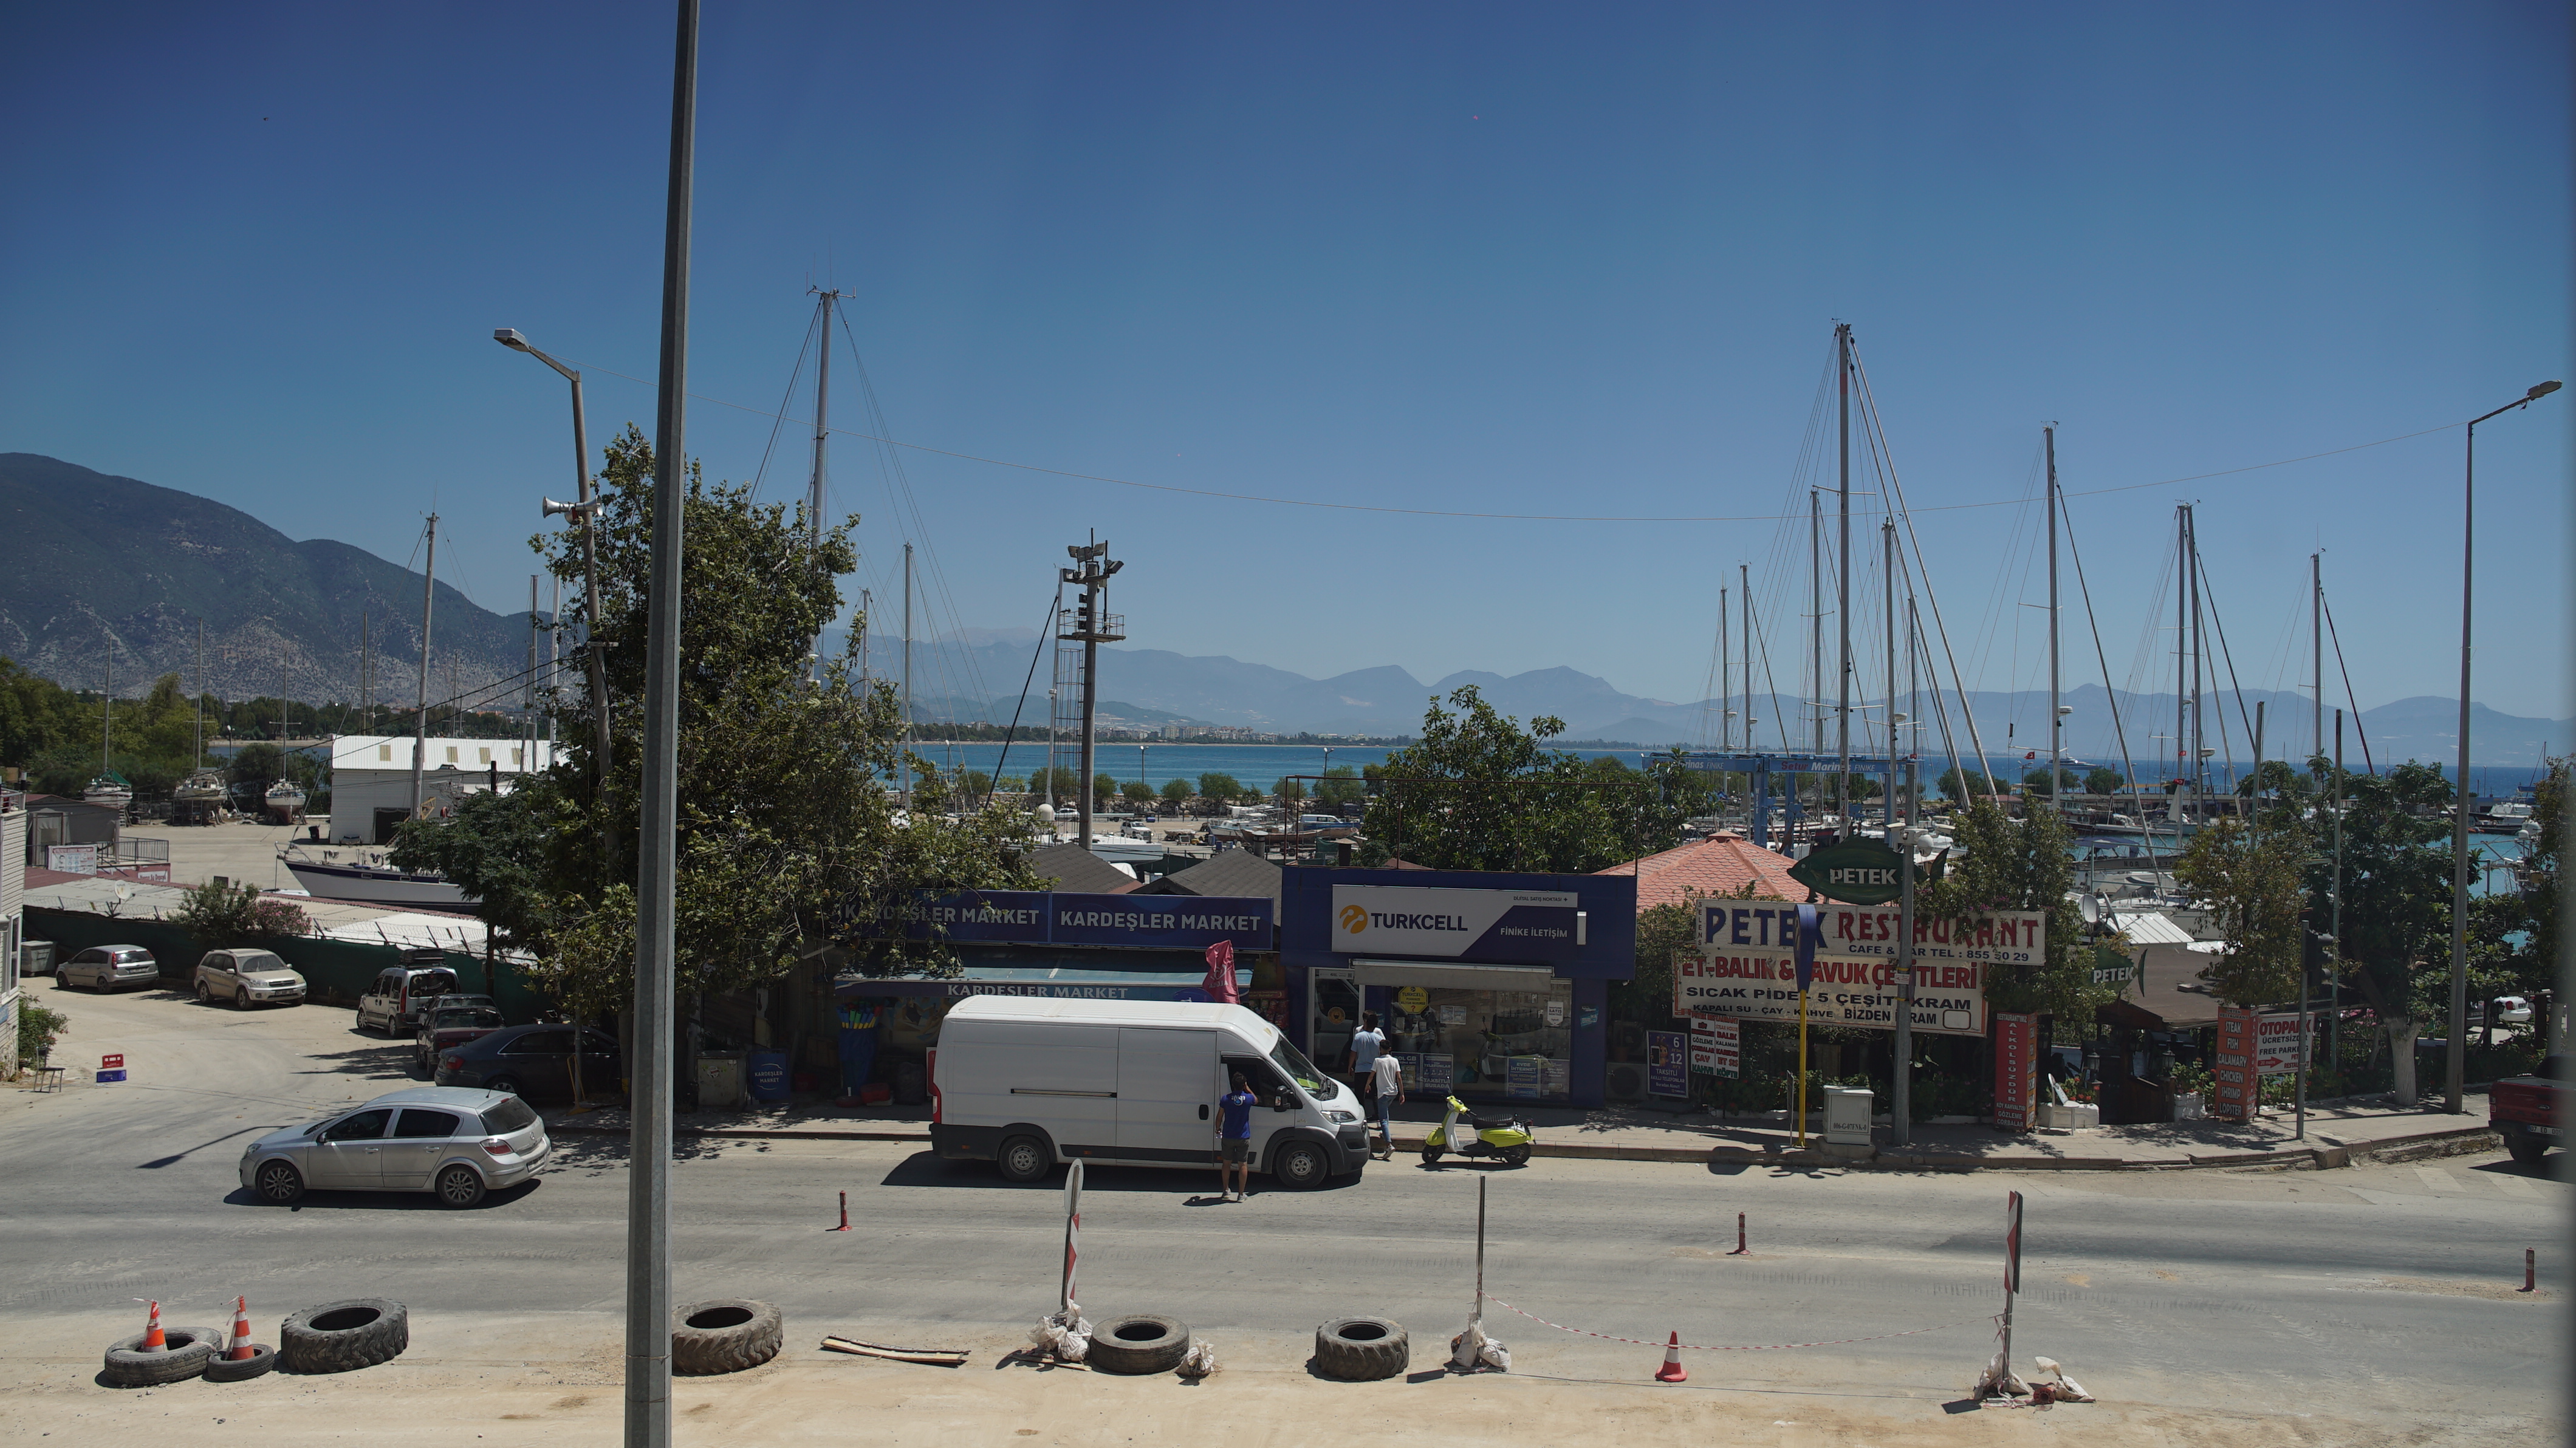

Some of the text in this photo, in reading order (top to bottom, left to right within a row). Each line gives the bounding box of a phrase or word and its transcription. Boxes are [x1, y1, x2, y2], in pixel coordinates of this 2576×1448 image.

[1781, 761, 1808, 771] Setur
[1811, 762, 1851, 772] Marins
[1829, 868, 1897, 885] PETEK
[962, 907, 1040, 924] MARKET
[1061, 911, 1261, 932] KARDEŞLER MARKET
[1371, 912, 1468, 932] TURKCELL
[1500, 926, 1568, 940] FİNİKE İLETİŞİM
[1849, 945, 1882, 954] CAFE
[1931, 949, 1954, 958] TEL
[1967, 950, 1990, 959] 855
[2013, 952, 2029, 961] 29
[1779, 960, 1795, 981] &
[1810, 961, 1869, 985] AVUK
[2093, 967, 2134, 983] PETEK
[1054, 987, 1128, 999] MARKET
[1687, 987, 1747, 999] SICAK
[1753, 988, 1798, 1001] PİDE
[1818, 993, 1829, 1002] 5
[1835, 993, 1894, 1008] ÇEŞİT
[1693, 1005, 1732, 1013] KAPALI
[1845, 1009, 1891, 1022] BİZDEN
[2225, 1021, 2242, 1034] STEAK
[1673, 1037, 1680, 1048] 6
[1693, 1036, 1713, 1045] GÖZLEME
[2227, 1037, 2239, 1050] FISH
[1671, 1053, 1682, 1065] 12
[1694, 1054, 1710, 1063] ÇAY
[1718, 1057, 1727, 1065] ET
[2218, 1053, 2247, 1068] CALAMARY
[2220, 1069, 2244, 1084] CHICKEN
[2221, 1087, 2241, 1099] SHRIMP
[1998, 1110, 2023, 1120] GÖZLEME
[2219, 1102, 2242, 1116] LOPSTER
